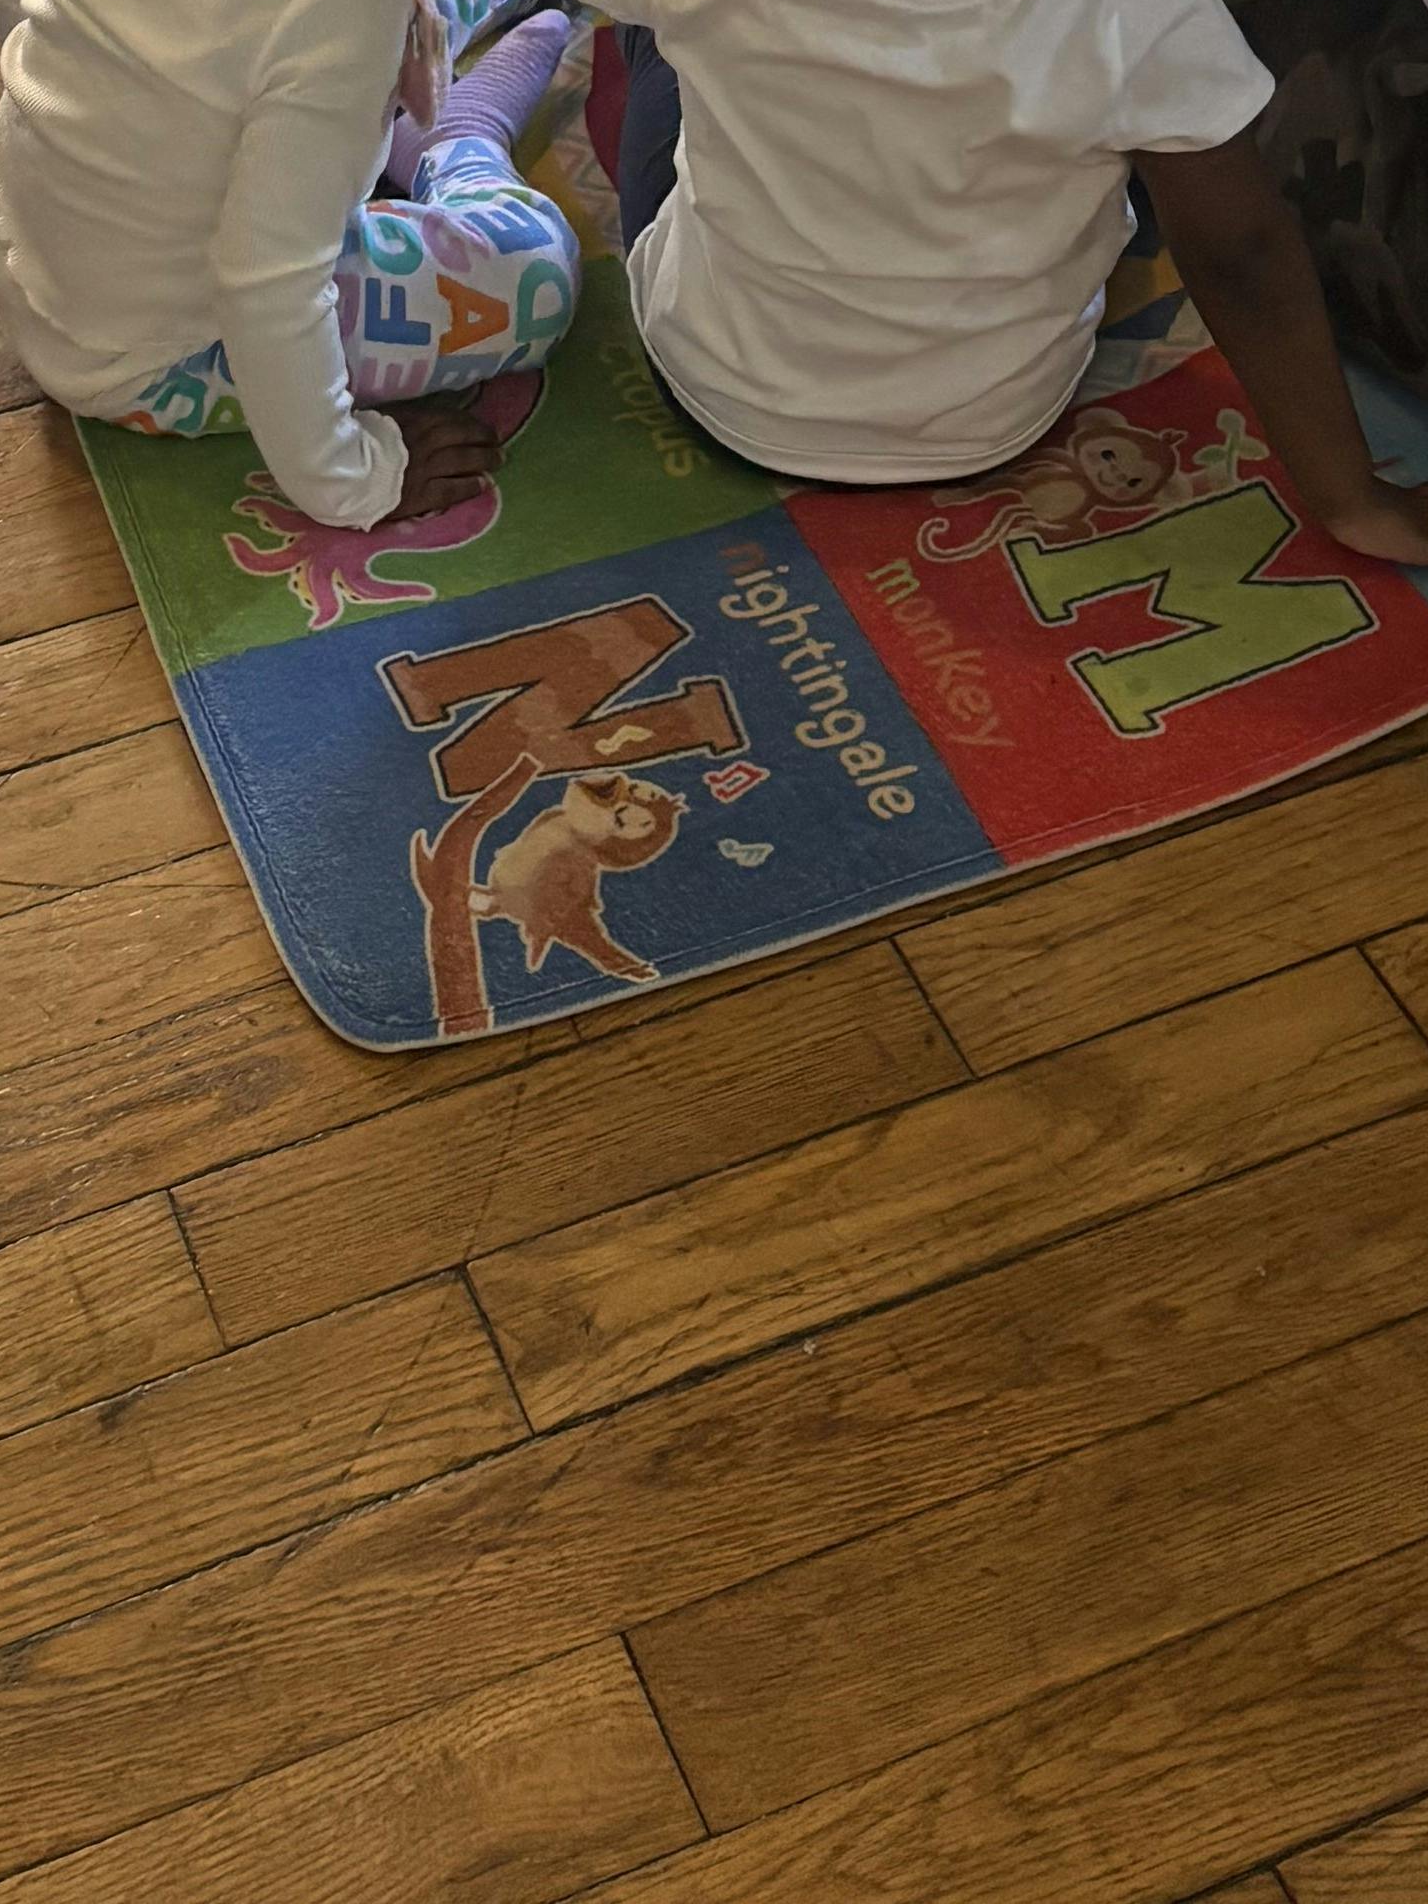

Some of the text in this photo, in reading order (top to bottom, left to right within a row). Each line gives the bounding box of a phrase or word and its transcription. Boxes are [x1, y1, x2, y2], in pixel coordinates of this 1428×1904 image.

[374, 592, 751, 805] N
[716, 539, 920, 822] nightingale
[864, 555, 1017, 751] monkey
[1000, 480, 1382, 742] M
